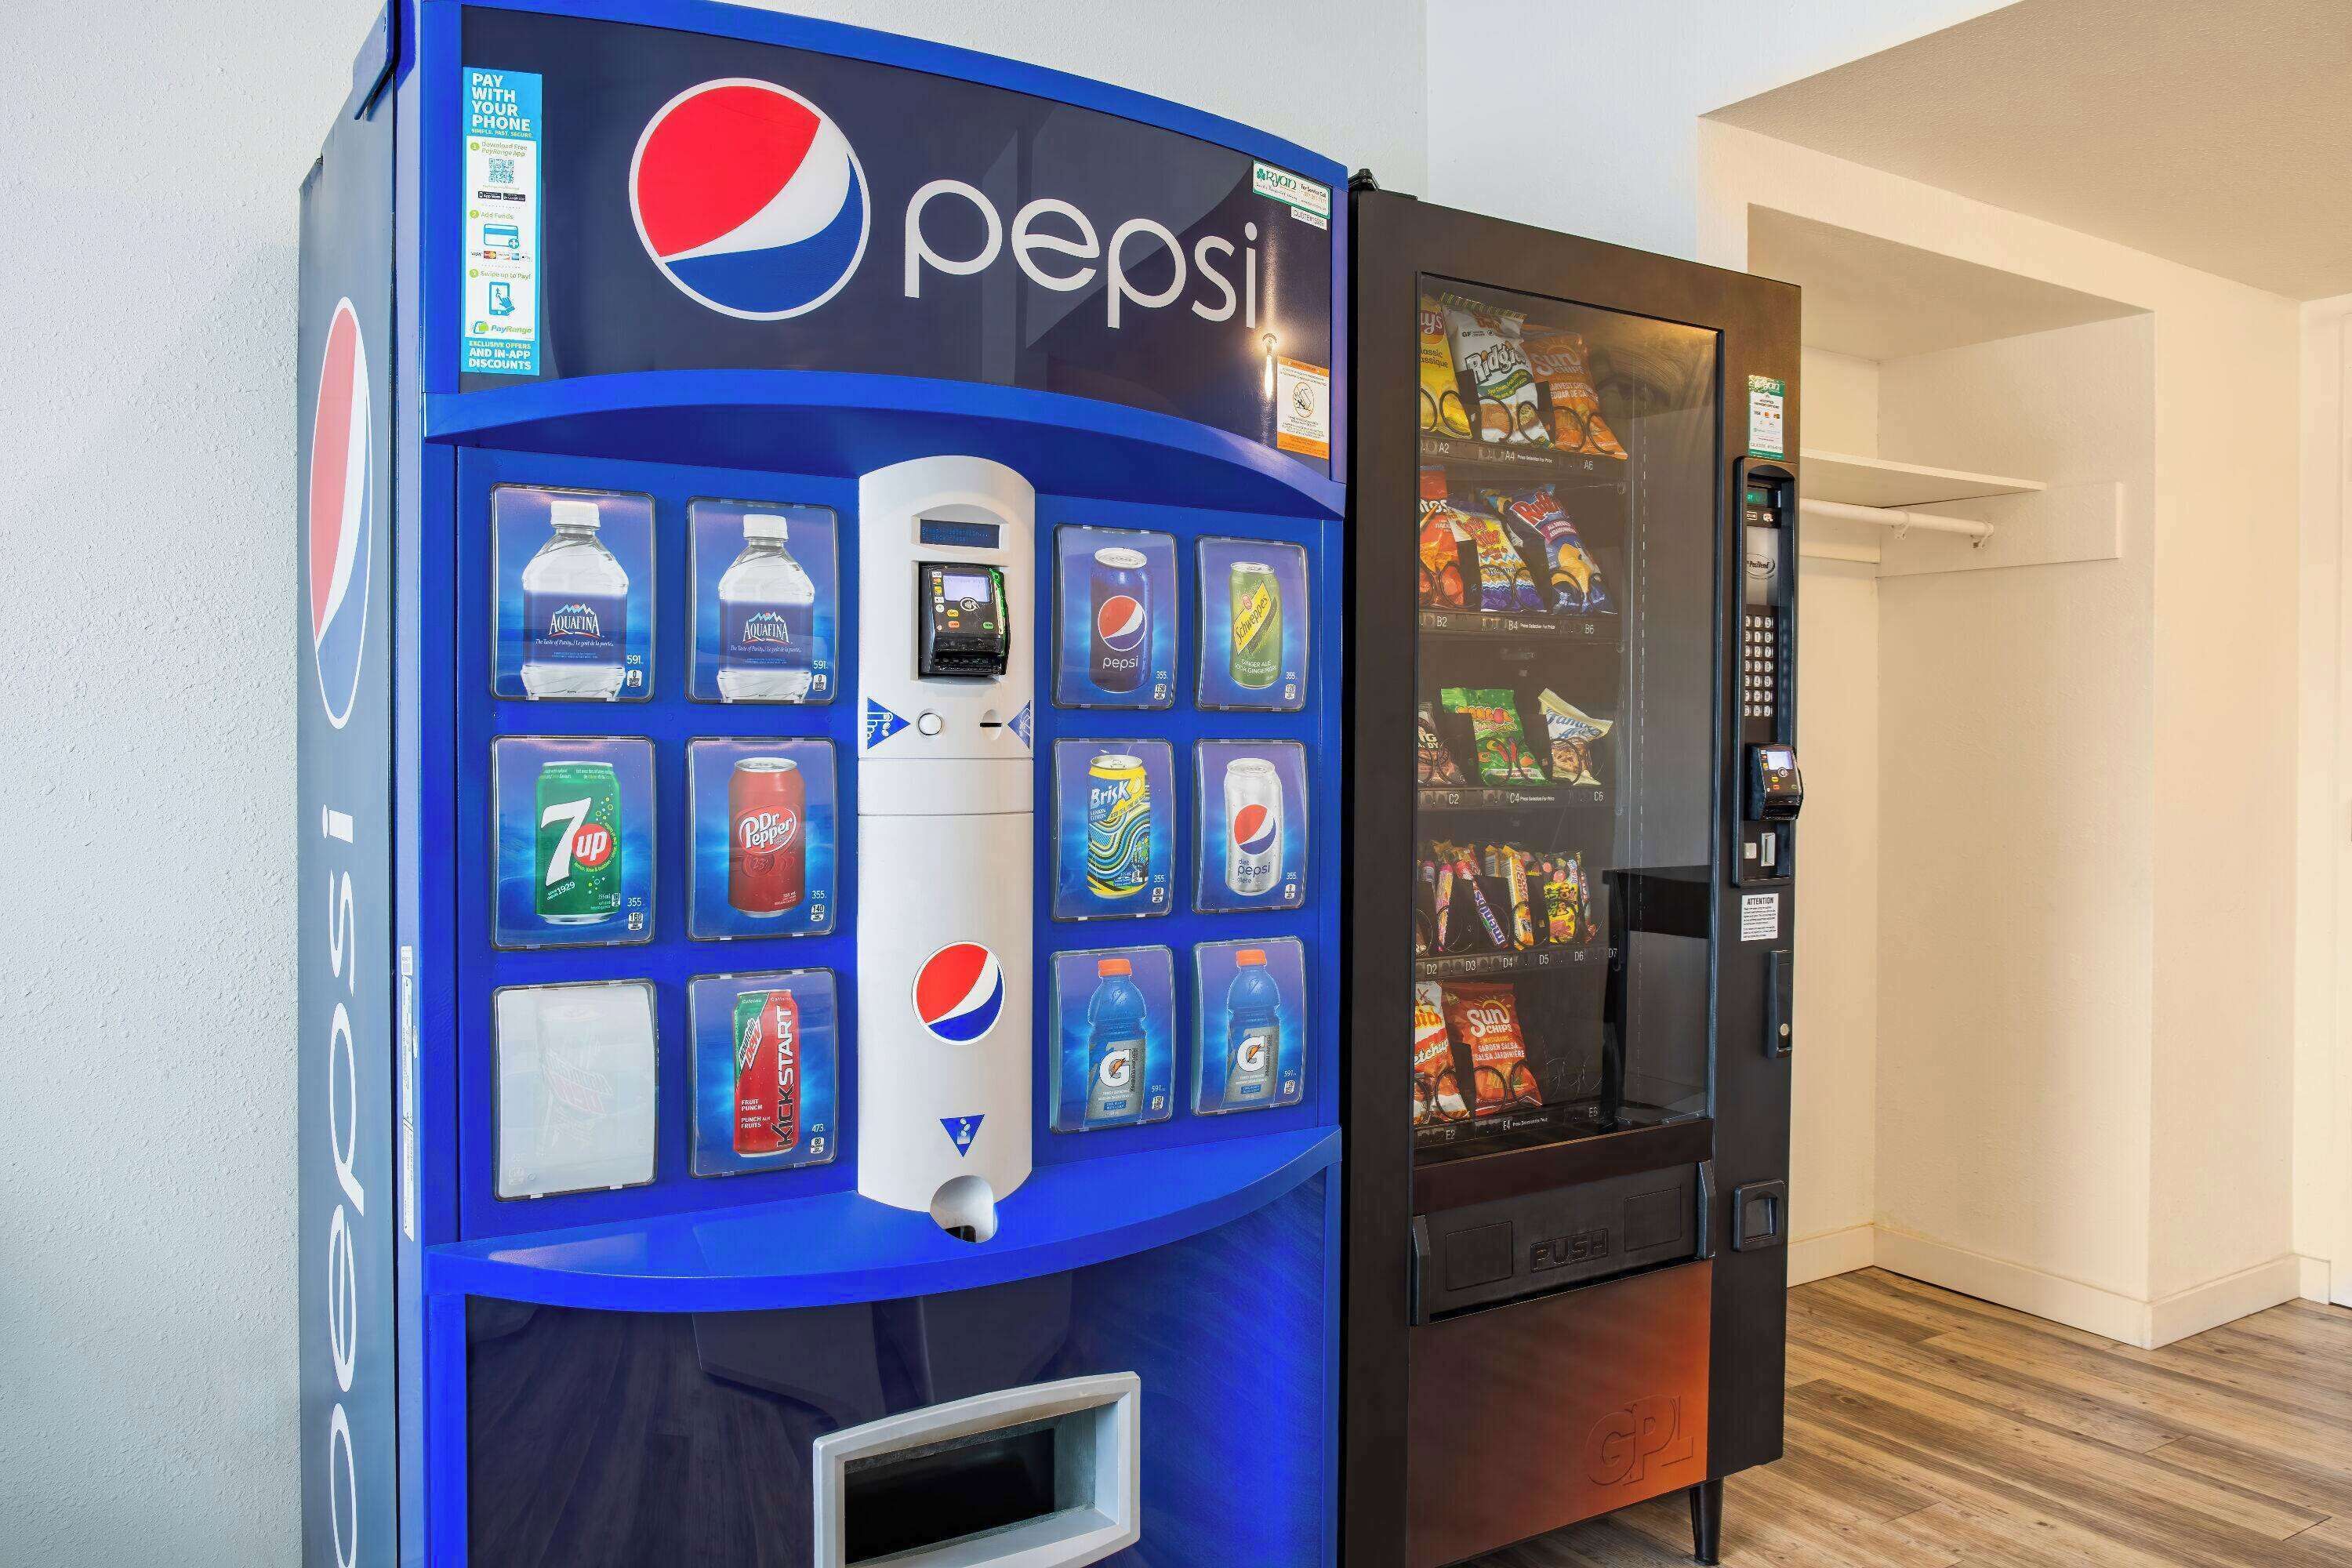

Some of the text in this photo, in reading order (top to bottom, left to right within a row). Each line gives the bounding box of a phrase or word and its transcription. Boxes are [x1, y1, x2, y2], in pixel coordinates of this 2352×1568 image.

[472, 72, 504, 88] PAY
[472, 88, 515, 103] WITH
[472, 100, 518, 117] YOUR
[472, 114, 531, 131] PHONE
[905, 179, 1258, 328] pepsi
[491, 325, 532, 334] PayRange
[470, 348, 531, 359] AND IN-APP
[468, 358, 532, 370] DISCOUNTS
[1439, 444, 1449, 454] A2
[549, 612, 601, 637] AQUAFINA
[1235, 595, 1269, 646] Schweppes
[1436, 616, 1447, 627] B2
[1508, 620, 1518, 630] B4
[742, 621, 790, 643] AQUAFINA
[1103, 655, 1138, 671] pepsi
[1241, 659, 1261, 667] GINGER
[1449, 793, 1459, 804] C2
[1594, 792, 1603, 801] C6
[759, 812, 780, 831] Dr
[739, 816, 793, 848] Pepper
[540, 797, 608, 887] 7 up
[1237, 862, 1272, 878] pepsi
[557, 880, 575, 895] 1929
[811, 890, 825, 899] 355
[627, 897, 642, 907] 355
[1748, 897, 1774, 906] ATTENTION
[630, 913, 642, 921] 160
[1426, 964, 1437, 975] D2
[1465, 961, 1476, 971] D3
[1503, 958, 1513, 968] D4
[1539, 954, 1549, 964] D5
[1574, 951, 1584, 961] D6
[1466, 1008, 1510, 1038] Sun
[1486, 1024, 1513, 1034] CHIPS
[1237, 1036, 1265, 1072] G
[1478, 1042, 1519, 1053] GARDEN SALSA
[1474, 1053, 1494, 1062] SALSA
[1099, 1049, 1130, 1087] G
[771, 1005, 794, 1148] KICKSTART
[1504, 1120, 1510, 1130] E4
[1446, 1131, 1455, 1140] E2
[1534, 1230, 1606, 1271] PUSH
